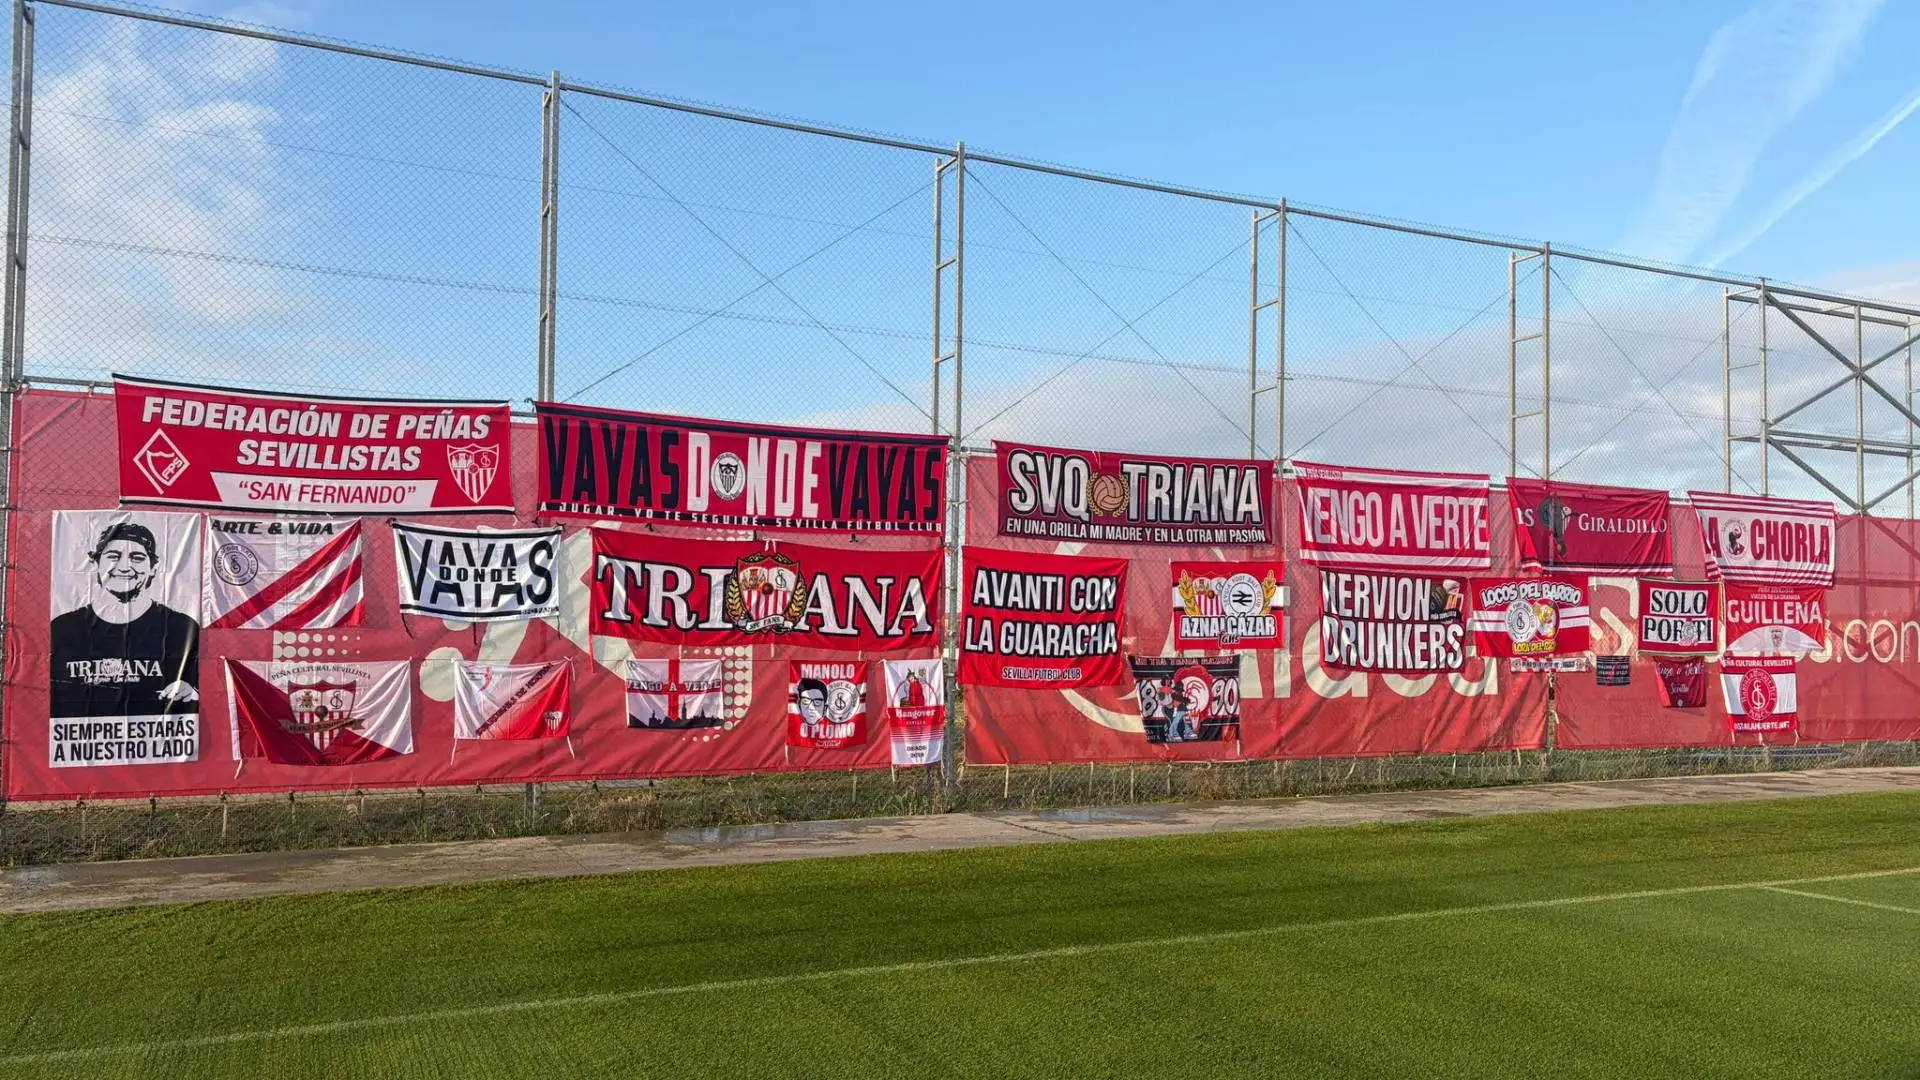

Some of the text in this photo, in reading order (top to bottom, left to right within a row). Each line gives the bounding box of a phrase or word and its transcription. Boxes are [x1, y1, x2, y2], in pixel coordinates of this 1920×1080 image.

[142, 396, 491, 440] FEDERACIÓN DE PEÑAS
[237, 439, 422, 471] SEVILLISTAS
[544, 417, 679, 509] VAYAS
[829, 443, 940, 520] VAYAS
[1010, 452, 1263, 523] SVQ TRIANA
[211, 519, 334, 535] ARTE & VIDA
[540, 502, 548, 512] A
[635, 507, 654, 518] YO
[665, 511, 681, 521] TE
[776, 517, 838, 530] SEVILLA
[909, 522, 942, 532] CLUB
[1007, 517, 1265, 542] EN UNA ORILLA MI MADRE Y EN LA OTRA MI PASIÓN
[1298, 486, 1490, 550] VENGO A VERTE
[1750, 518, 1830, 564] CHORLA
[439, 566, 517, 582] DONDE
[596, 554, 933, 637] TRIANA
[973, 569, 1117, 611] AVANTI CON
[1320, 570, 1431, 621] NERVION
[1482, 582, 1581, 607] LOCOS DEL BARRIO
[1652, 590, 1707, 614] SOLO
[1181, 612, 1276, 637] AZNALCÁZAR
[1727, 599, 1823, 625] GUILLENA
[964, 617, 1117, 656] LA GUARACHA
[1323, 615, 1464, 669] DRUNKERS
[66, 659, 163, 678] TRIANA
[271, 664, 371, 680] PEÑA CULTURAL SEVILLISTA
[801, 663, 855, 680] MANOLO
[1003, 667, 1033, 679] SEVILLA
[1062, 667, 1081, 679] CLUB
[1735, 659, 1763, 667] CULTURAL
[626, 679, 663, 691] VENGO
[669, 682, 678, 691] A
[1212, 677, 1240, 716] 90
[53, 717, 194, 741] SIEMPRE ESTARÁS
[800, 722, 856, 739] O PLOMO
[54, 739, 194, 762] A NUESTRO LADO
